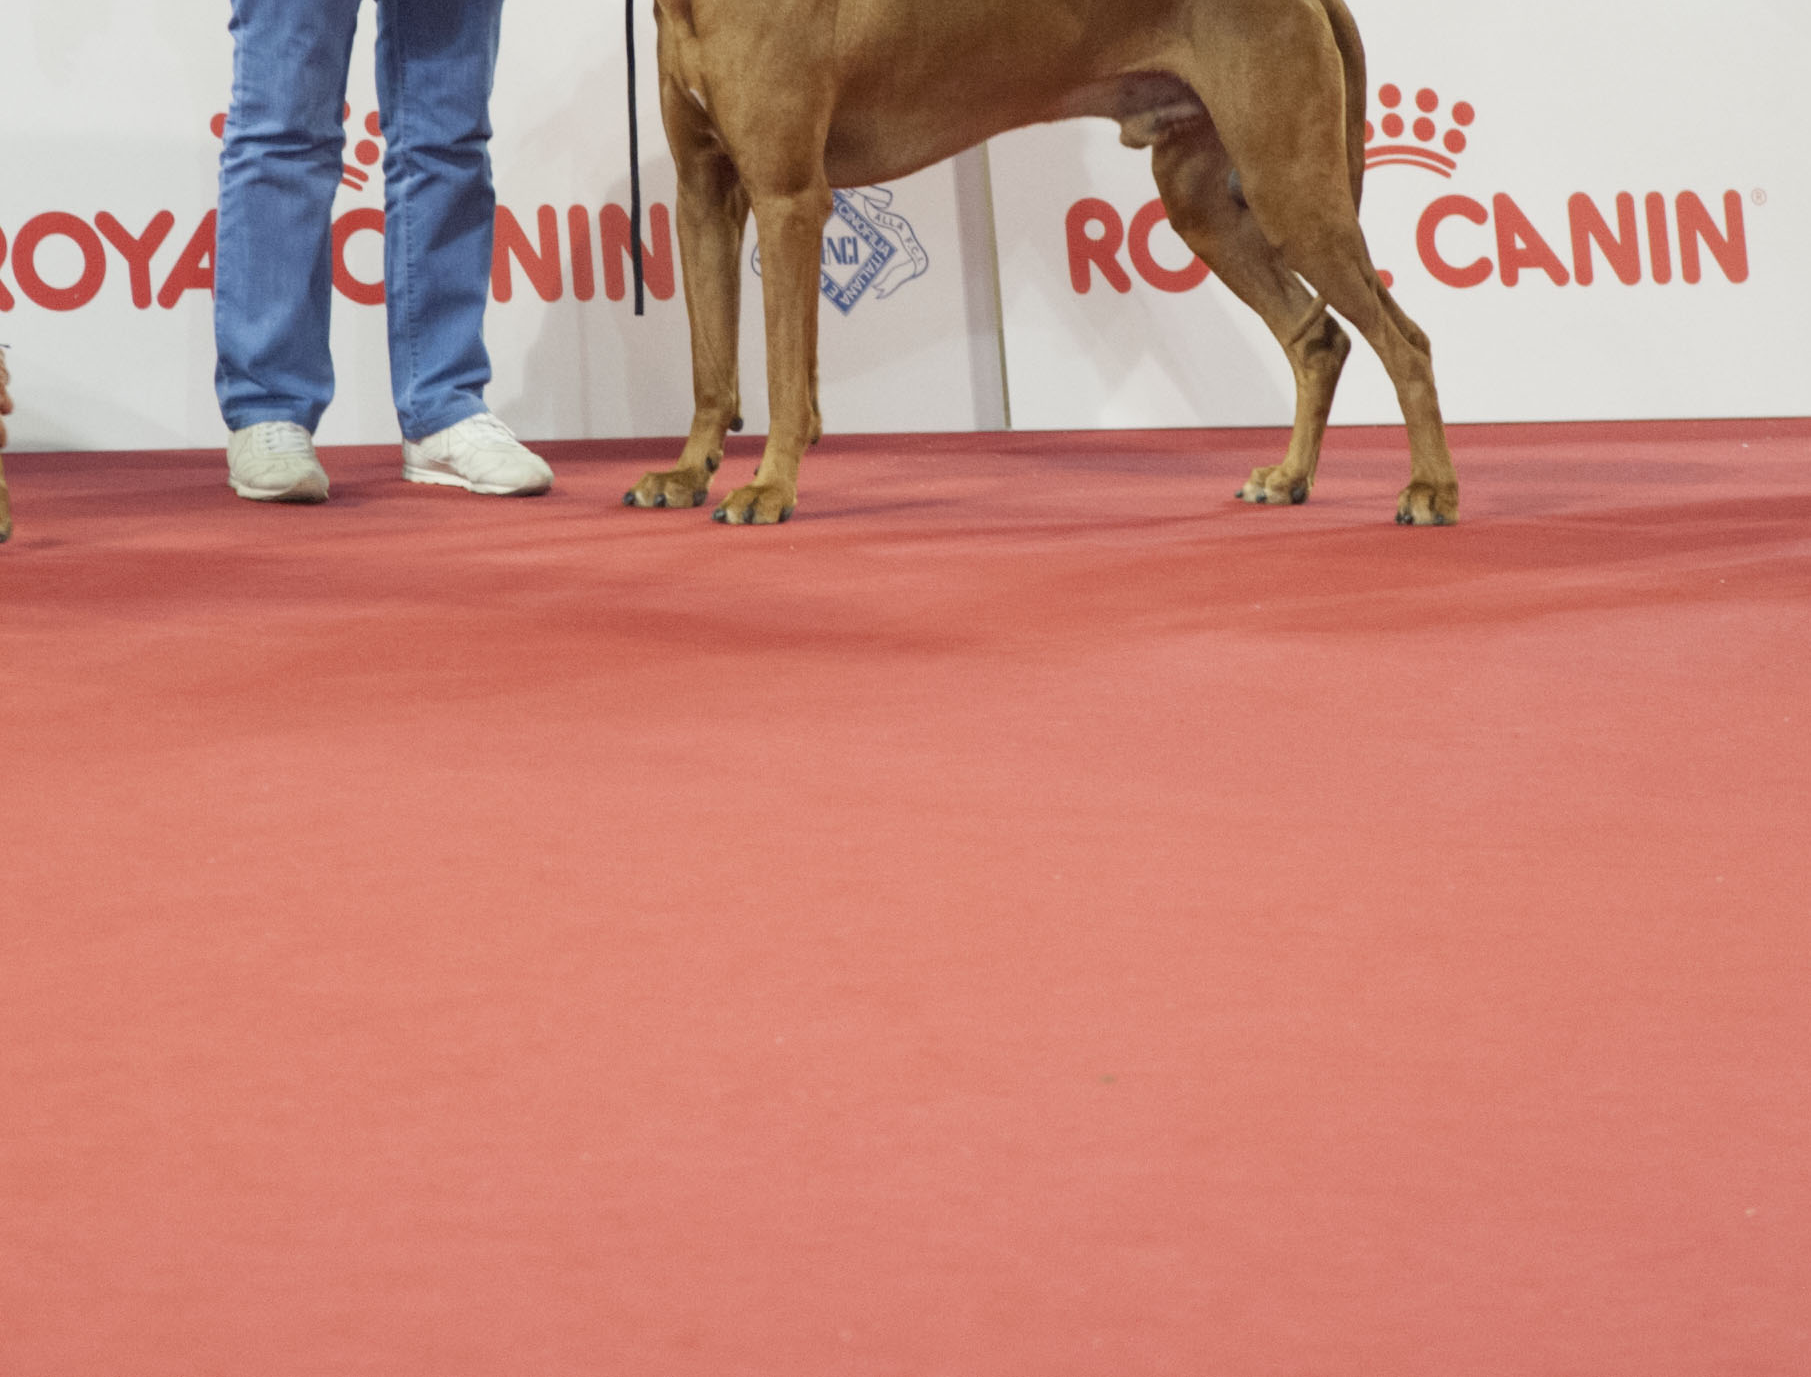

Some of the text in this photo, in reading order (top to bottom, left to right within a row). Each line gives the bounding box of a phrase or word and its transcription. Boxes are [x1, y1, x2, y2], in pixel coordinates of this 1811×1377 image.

[0, 202, 676, 312] OYA CNIN
[821, 236, 859, 266] NCI
[1415, 188, 1749, 289] CANIN
[838, 251, 886, 306] ITALIANA
